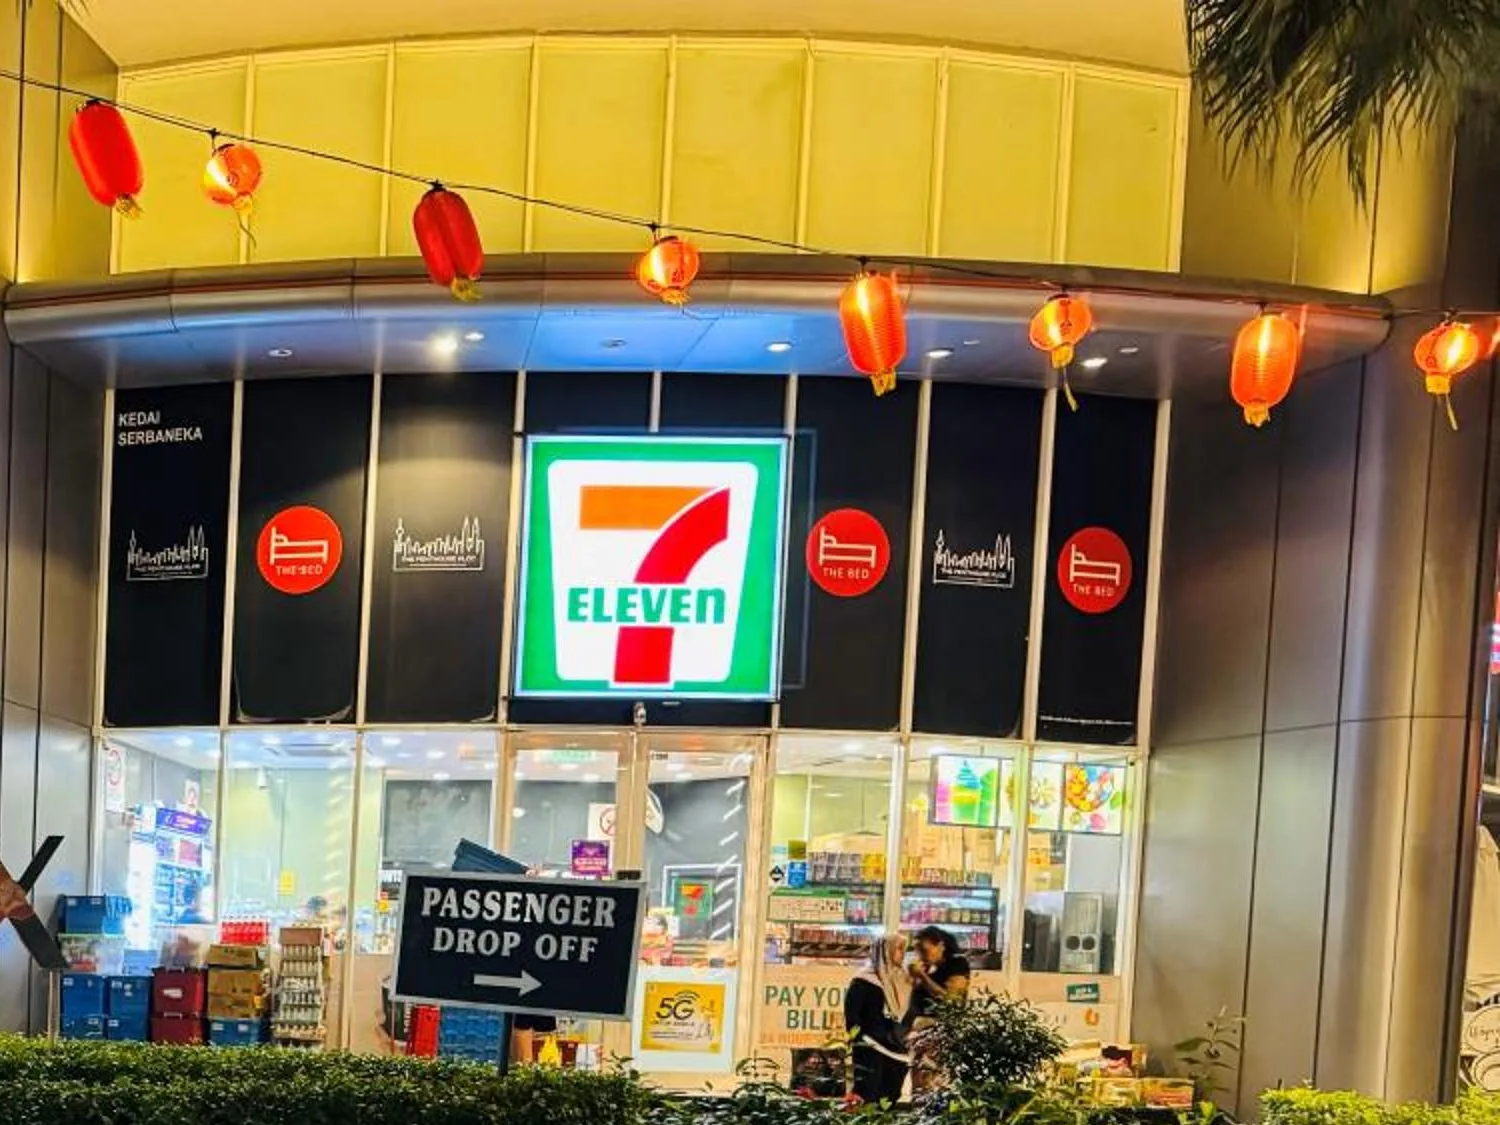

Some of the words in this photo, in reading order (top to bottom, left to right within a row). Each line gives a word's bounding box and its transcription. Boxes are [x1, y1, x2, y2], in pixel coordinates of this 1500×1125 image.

[118, 410, 161, 427] KEDAI
[117, 427, 203, 447] SERBANEKA
[276, 565, 296, 576] THE
[299, 563, 324, 576] BED
[823, 567, 845, 579] THE
[847, 567, 870, 579] BED
[579, 485, 731, 684] 7
[1073, 583, 1092, 596] THE
[1094, 584, 1116, 597] BED
[420, 886, 618, 928] PASSENGER
[432, 927, 522, 957] DROP
[534, 933, 599, 963] OFF
[764, 985, 806, 1007] PAY
[813, 986, 848, 1008] YO
[655, 997, 695, 1020] 5G
